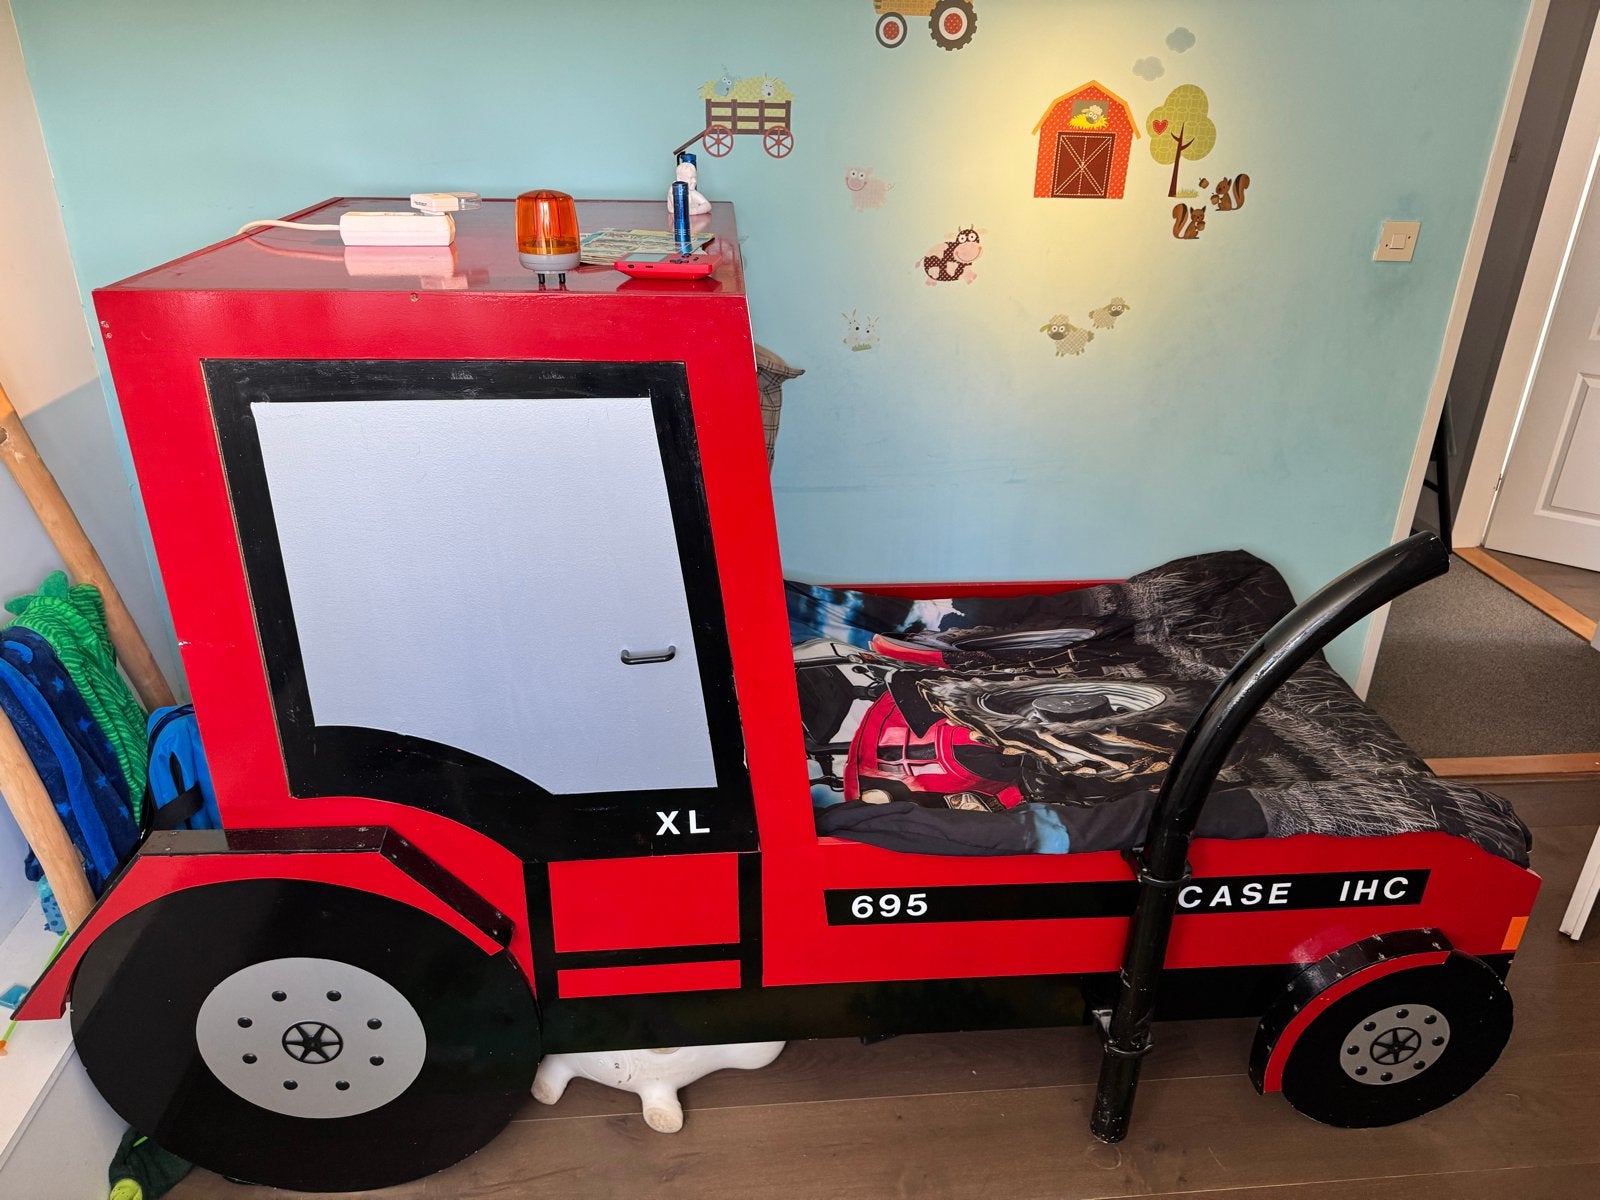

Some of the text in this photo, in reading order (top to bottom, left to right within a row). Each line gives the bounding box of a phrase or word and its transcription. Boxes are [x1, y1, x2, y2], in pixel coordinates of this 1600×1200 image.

[655, 809, 711, 836] XL
[851, 893, 928, 919] 695
[1177, 876, 1409, 909] CASE IHC
